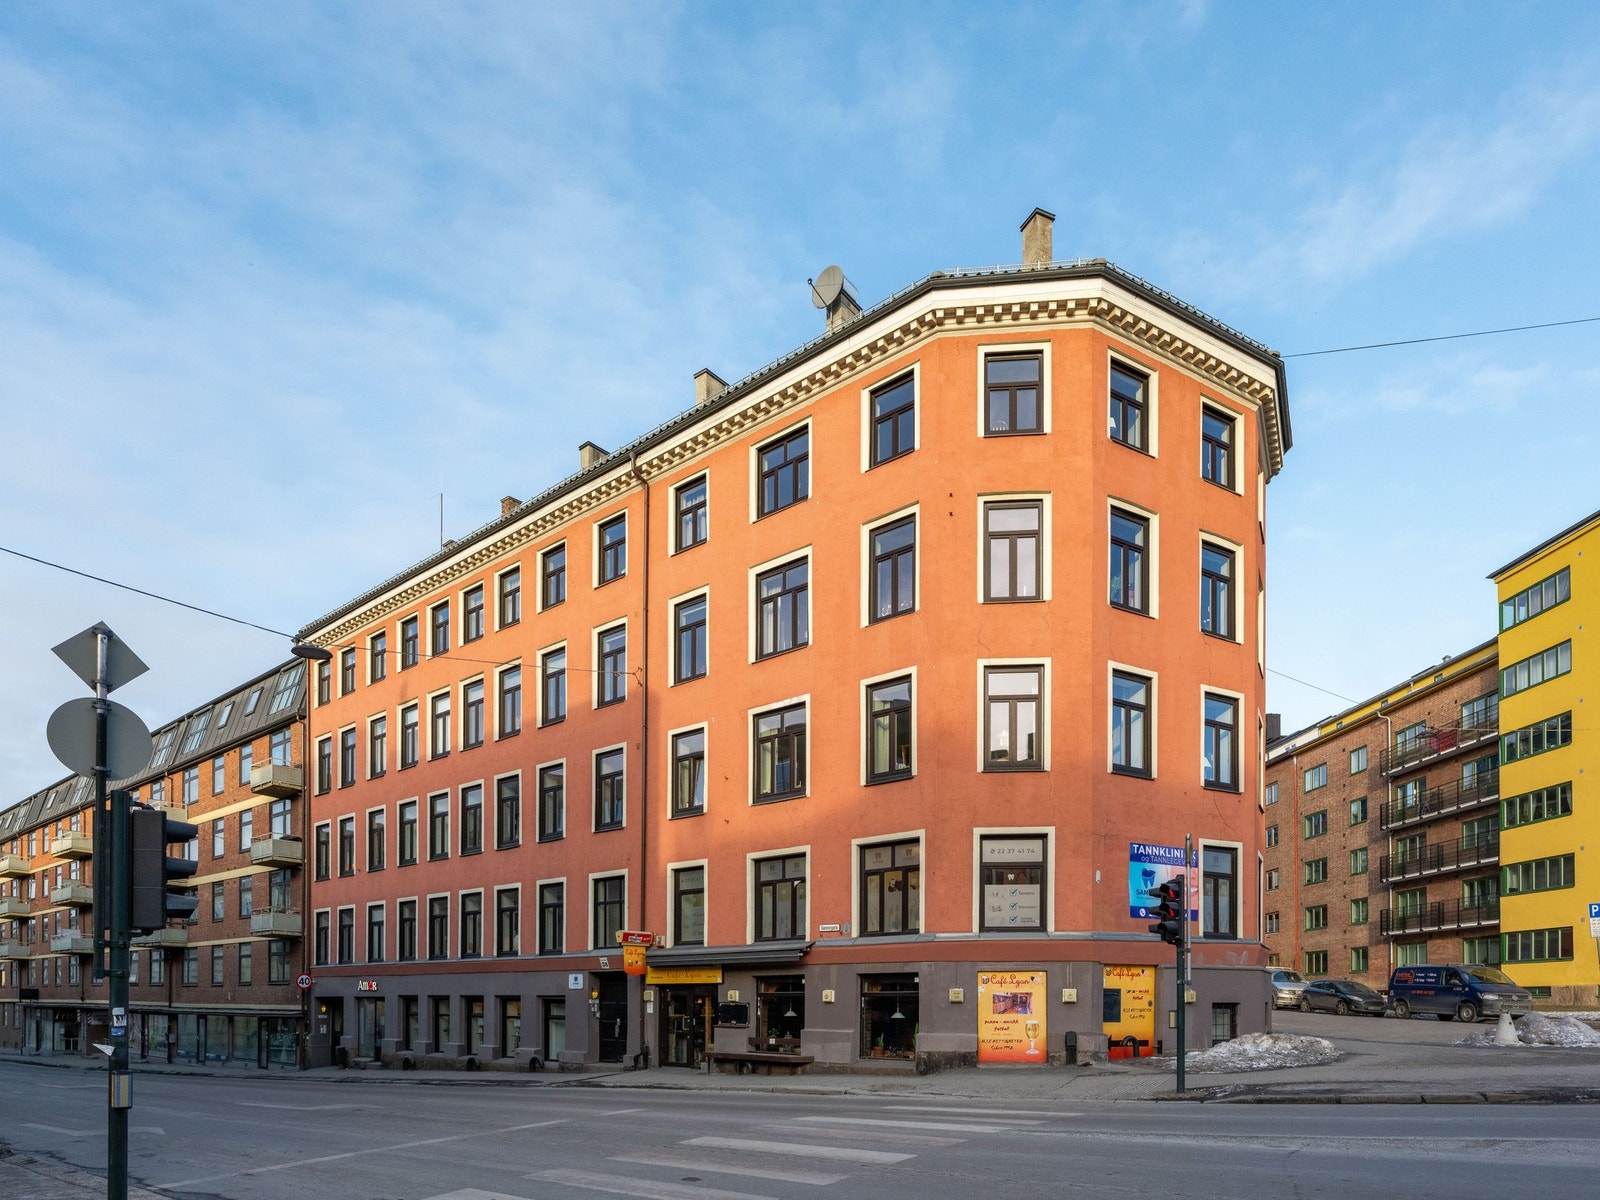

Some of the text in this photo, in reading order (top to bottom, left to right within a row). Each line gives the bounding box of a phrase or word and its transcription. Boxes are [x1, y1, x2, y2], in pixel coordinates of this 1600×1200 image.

[1133, 845, 1197, 860] TANNKLINIK
[1591, 905, 1599, 916] P
[1112, 966, 1141, 981] Café Lyon
[299, 977, 310, 985] 40
[990, 974, 1031, 988] Café Lyon
